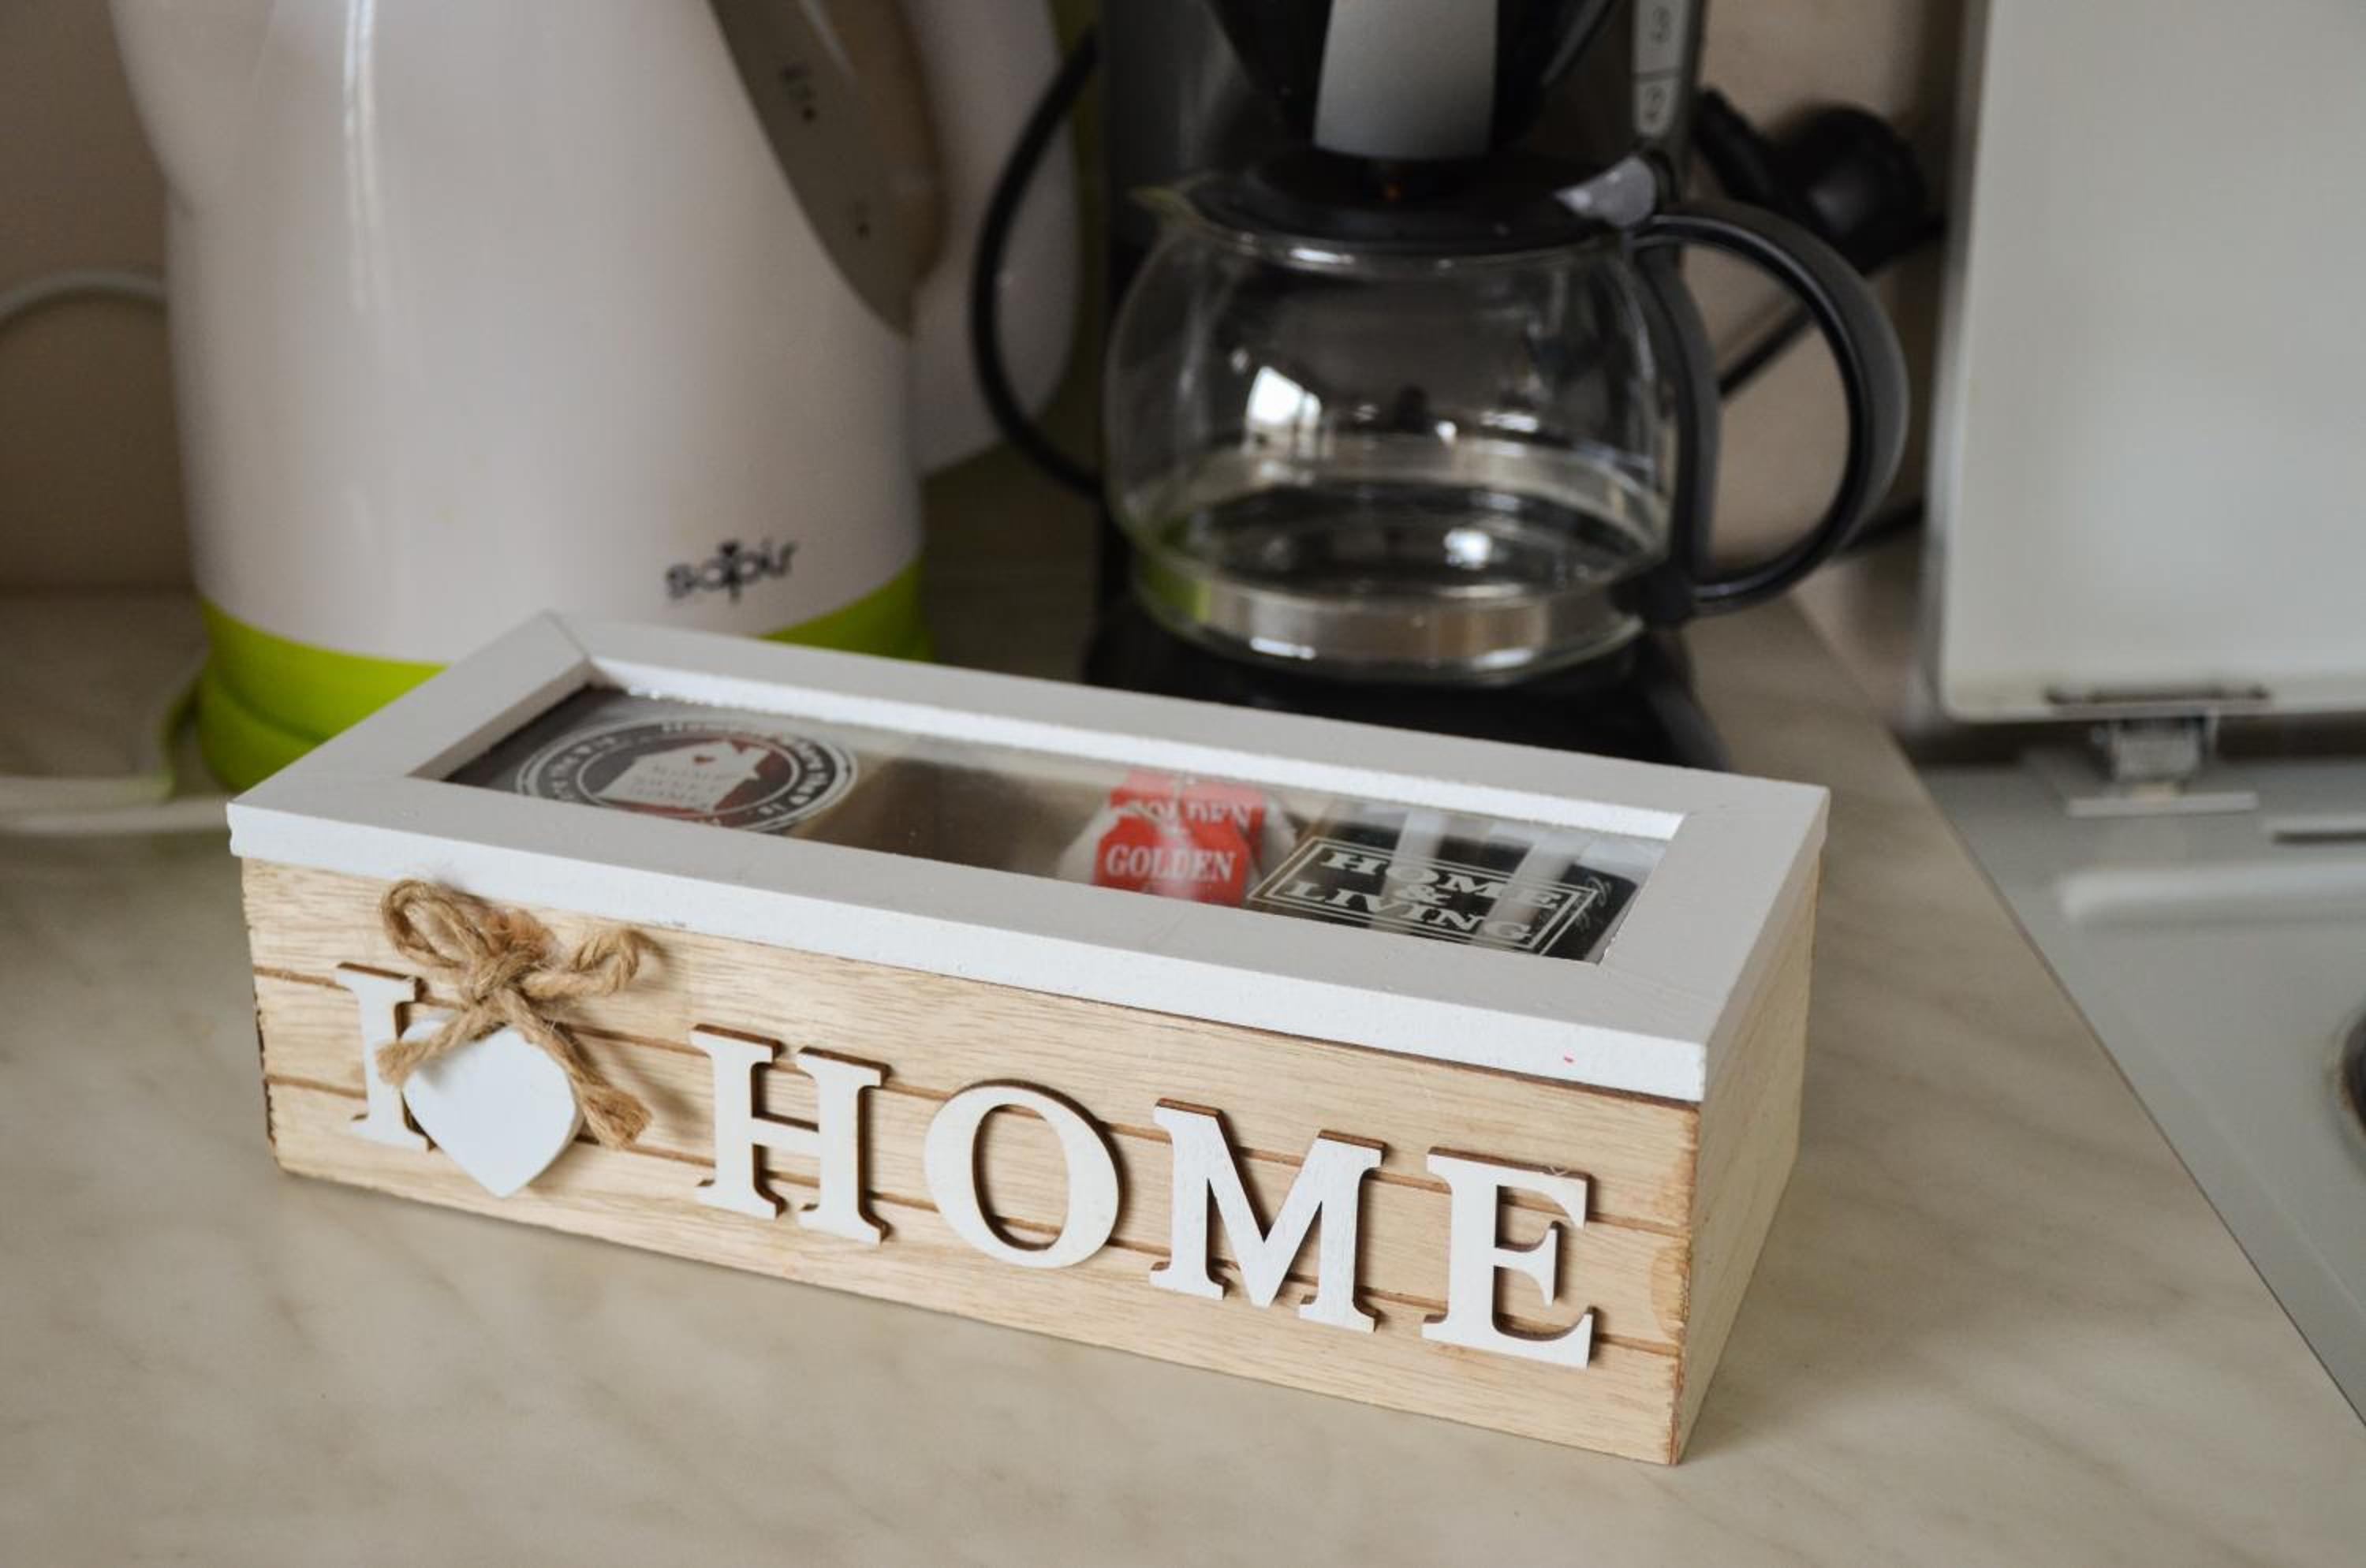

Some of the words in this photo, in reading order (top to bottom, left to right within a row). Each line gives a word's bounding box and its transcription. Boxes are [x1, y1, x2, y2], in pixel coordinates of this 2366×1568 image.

[665, 539, 795, 602] sapir
[1106, 843, 1236, 882] GOLDEN
[1321, 851, 1564, 908] HOME
[1285, 882, 1534, 940] LIVING
[335, 964, 435, 1150] I
[689, 1025, 1595, 1368] HOME
